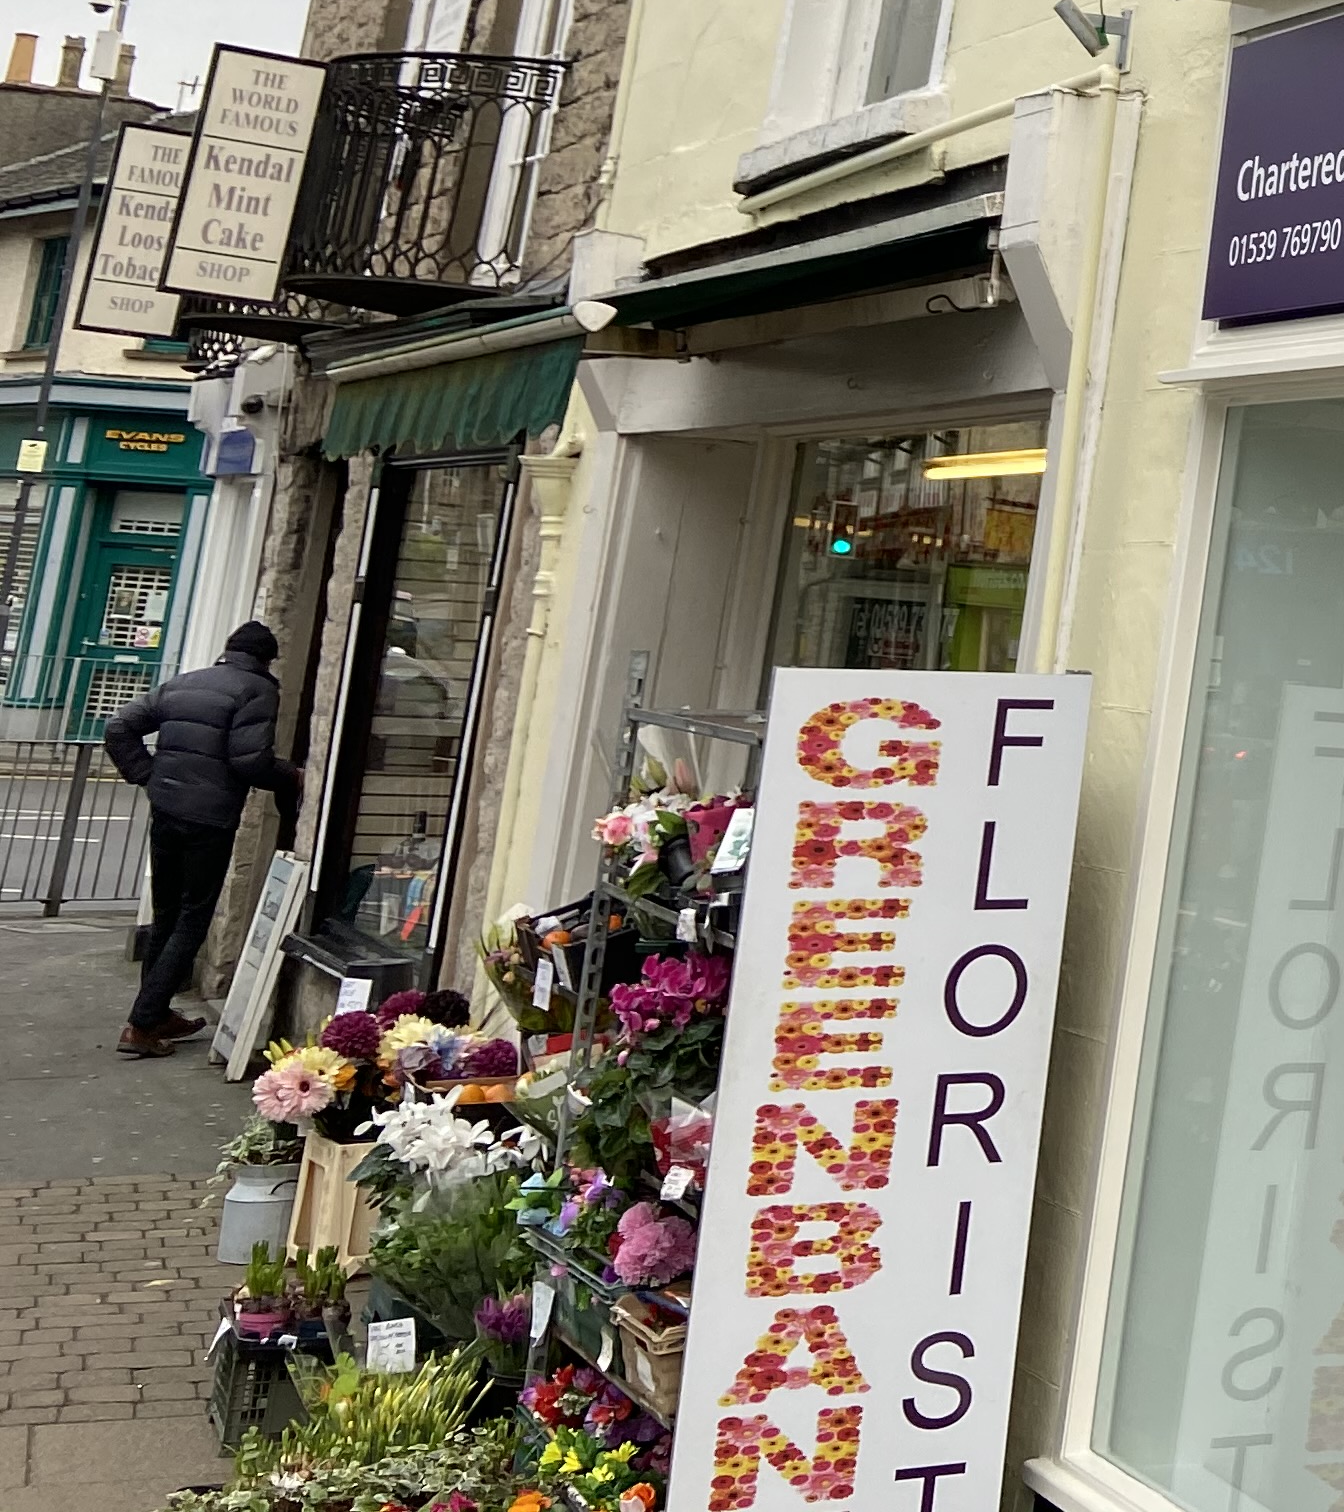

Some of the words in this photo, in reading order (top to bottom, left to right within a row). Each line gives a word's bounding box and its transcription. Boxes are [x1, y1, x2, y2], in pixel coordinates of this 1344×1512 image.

[252, 69, 288, 90] THE
[232, 88, 299, 115] WORLD
[219, 109, 298, 137] FAMOUS
[152, 145, 183, 165] THE
[204, 145, 296, 184] Kendal
[128, 164, 180, 189] FAMOU
[118, 194, 176, 223] Kenda
[208, 183, 273, 217] Mint
[118, 225, 165, 252] Loos
[201, 218, 264, 252] Cake
[1228, 229, 1277, 267] 01539
[1281, 218, 1341, 259] 769790
[100, 254, 160, 283] Tobac
[196, 260, 250, 284] SHOP
[109, 296, 155, 314] SHOP
[105, 429, 185, 443] EVANS
[119, 441, 168, 452] CYCLES
[708, 696, 942, 1511] GREENBAN
